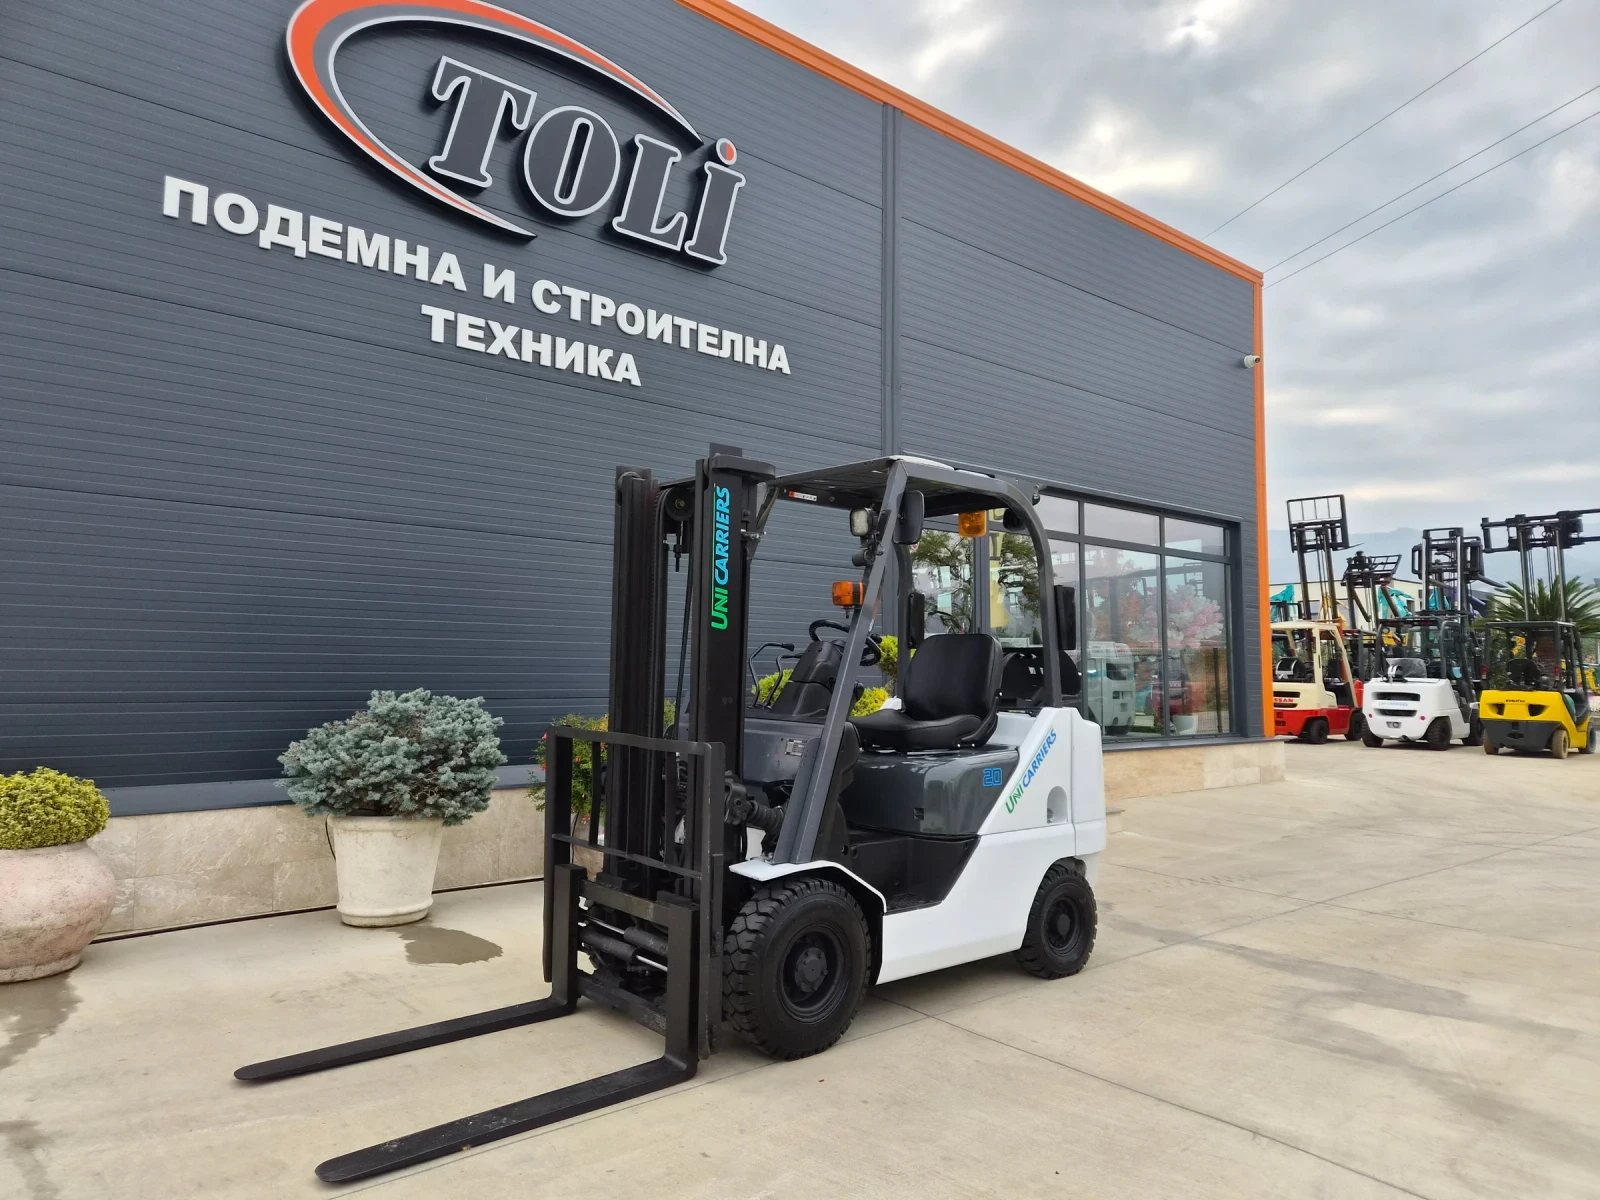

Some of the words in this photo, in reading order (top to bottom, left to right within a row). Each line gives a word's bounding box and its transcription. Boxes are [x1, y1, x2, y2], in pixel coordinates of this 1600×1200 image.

[161, 174, 467, 292] ПОДЕМНА
[482, 263, 516, 304] И
[531, 279, 792, 376] СТРОИТЕЛНА
[421, 304, 642, 387] ТЕХНИКА
[983, 767, 1003, 787] 20
